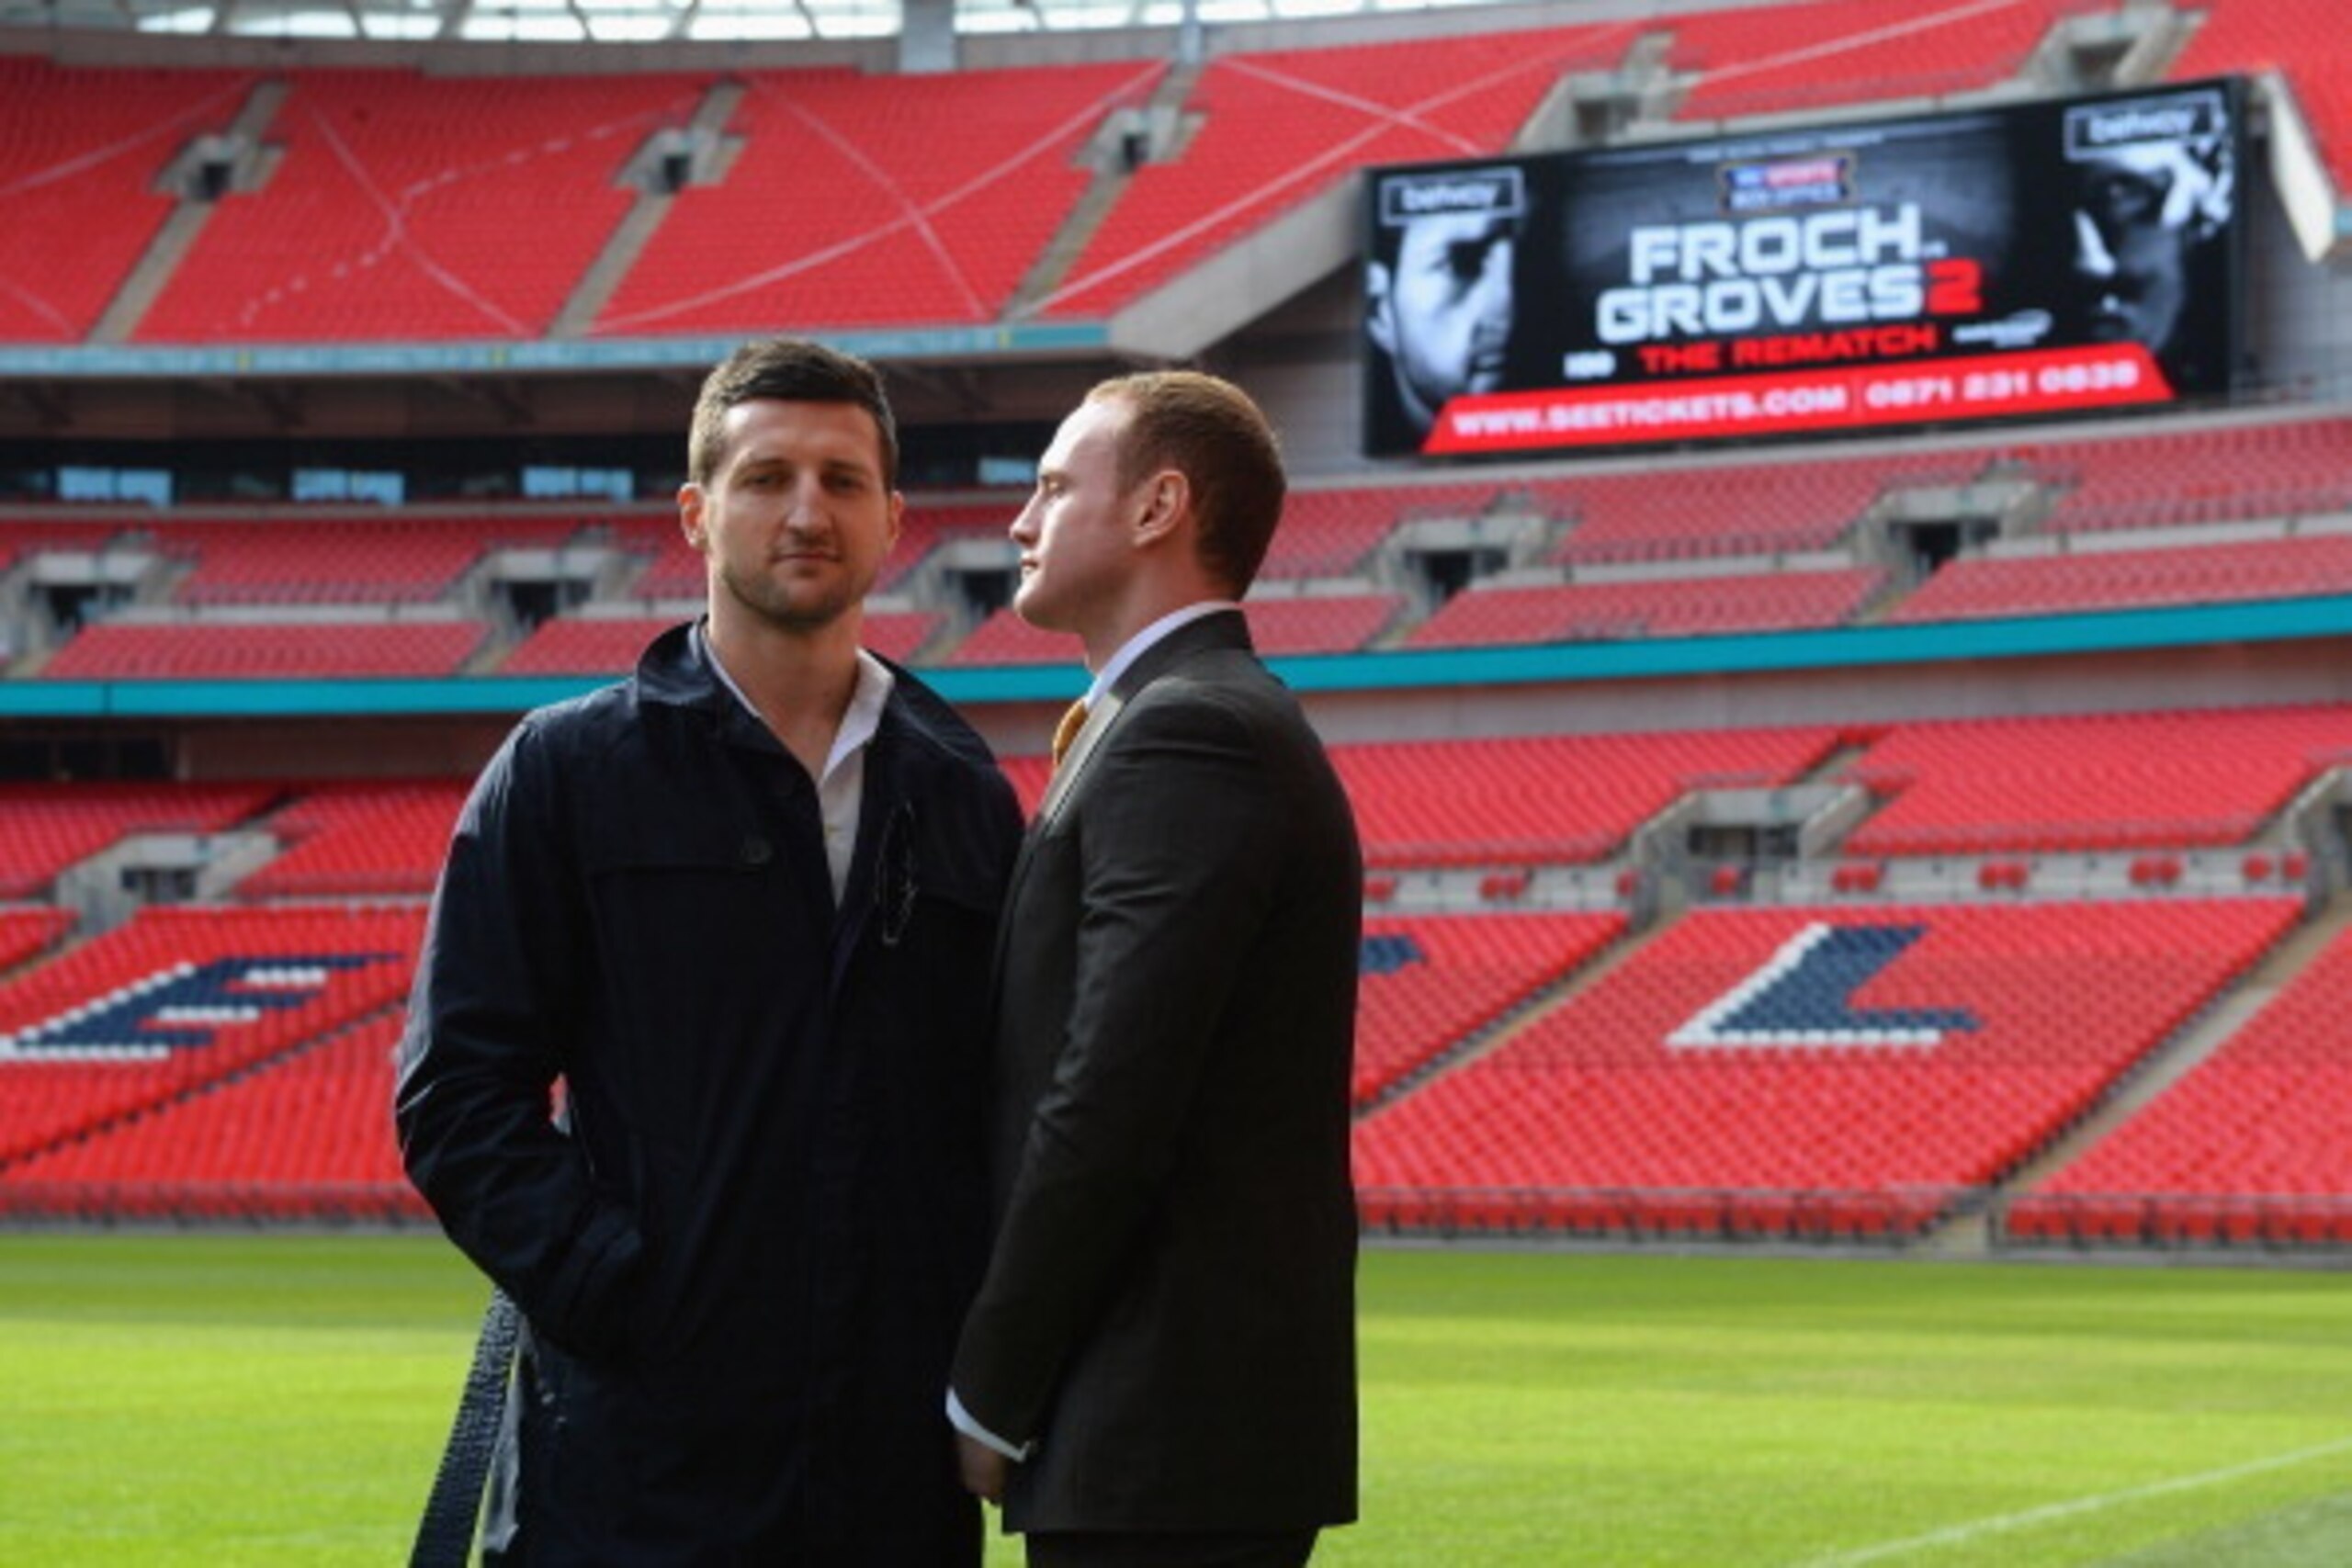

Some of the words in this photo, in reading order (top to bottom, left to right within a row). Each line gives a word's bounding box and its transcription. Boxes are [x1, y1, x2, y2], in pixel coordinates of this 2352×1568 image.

[1630, 203, 1922, 285] FROCH
[1596, 264, 1924, 344] GROVES
[1639, 343, 1718, 373] THE
[1734, 323, 1937, 365] REMATCH
